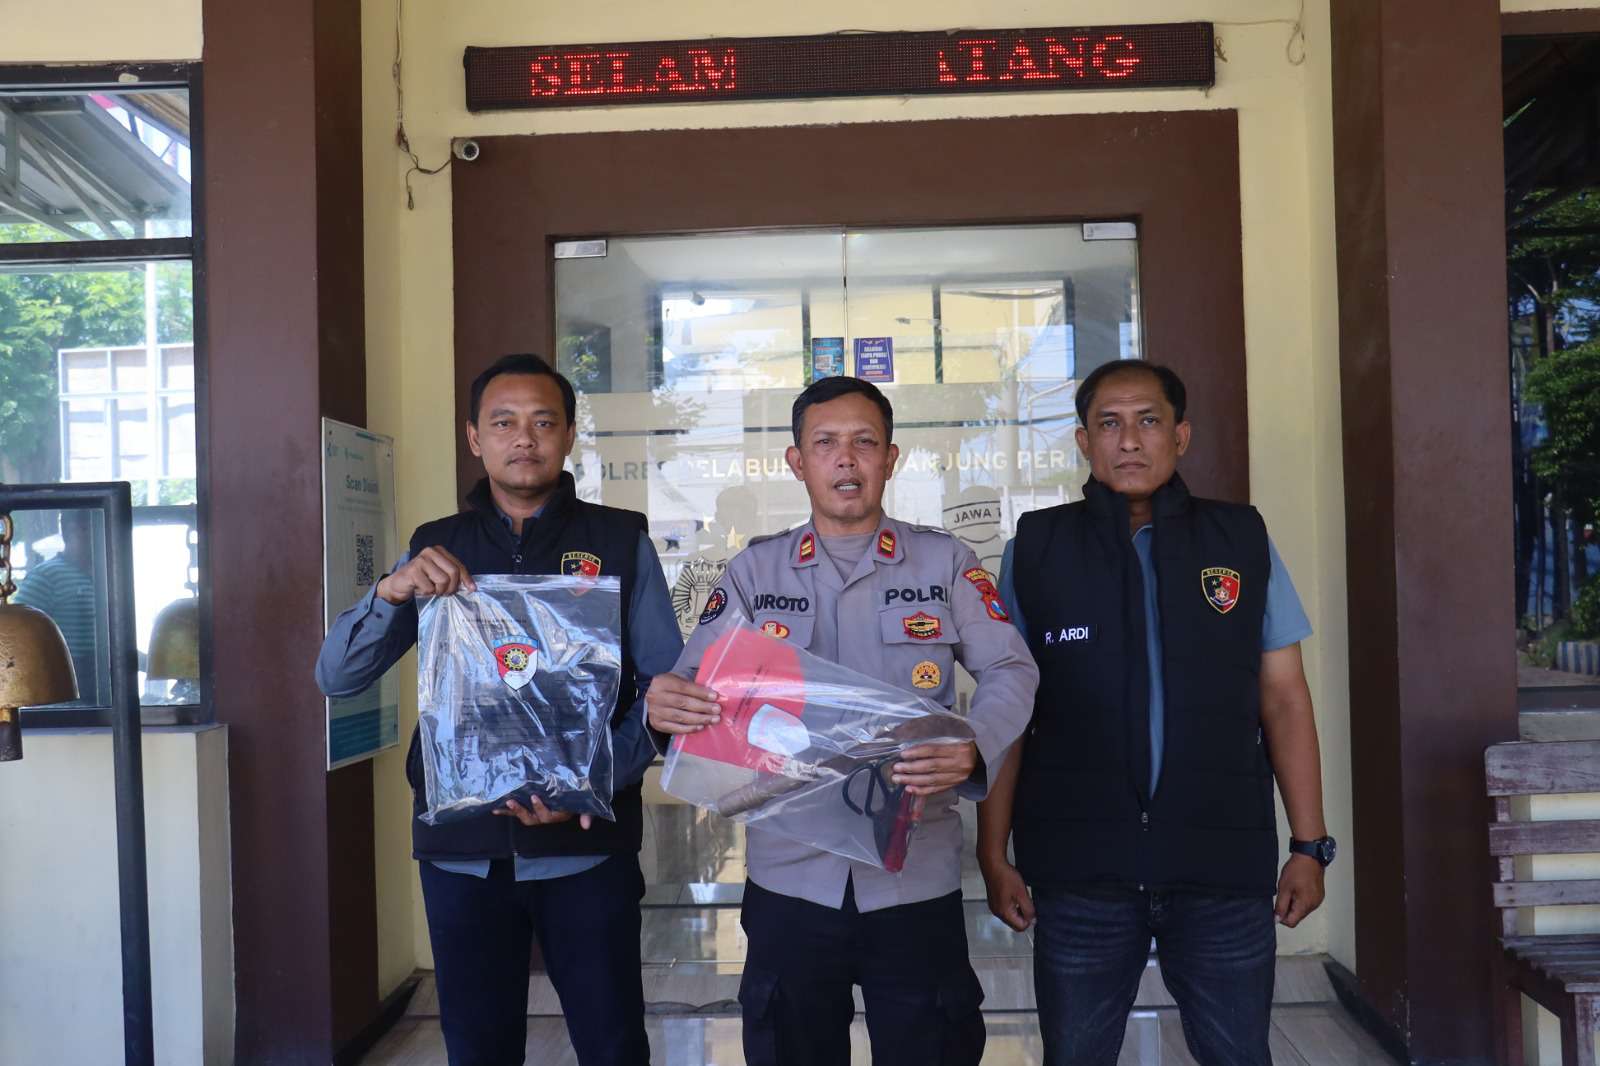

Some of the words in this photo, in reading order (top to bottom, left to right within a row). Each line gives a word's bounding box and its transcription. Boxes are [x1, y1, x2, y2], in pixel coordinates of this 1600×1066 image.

[953, 508, 992, 524] JAWA
[753, 593, 810, 613] UROTO
[884, 584, 949, 606] POLRI
[1045, 631, 1055, 646] R.
[1058, 626, 1089, 643] ARDI
